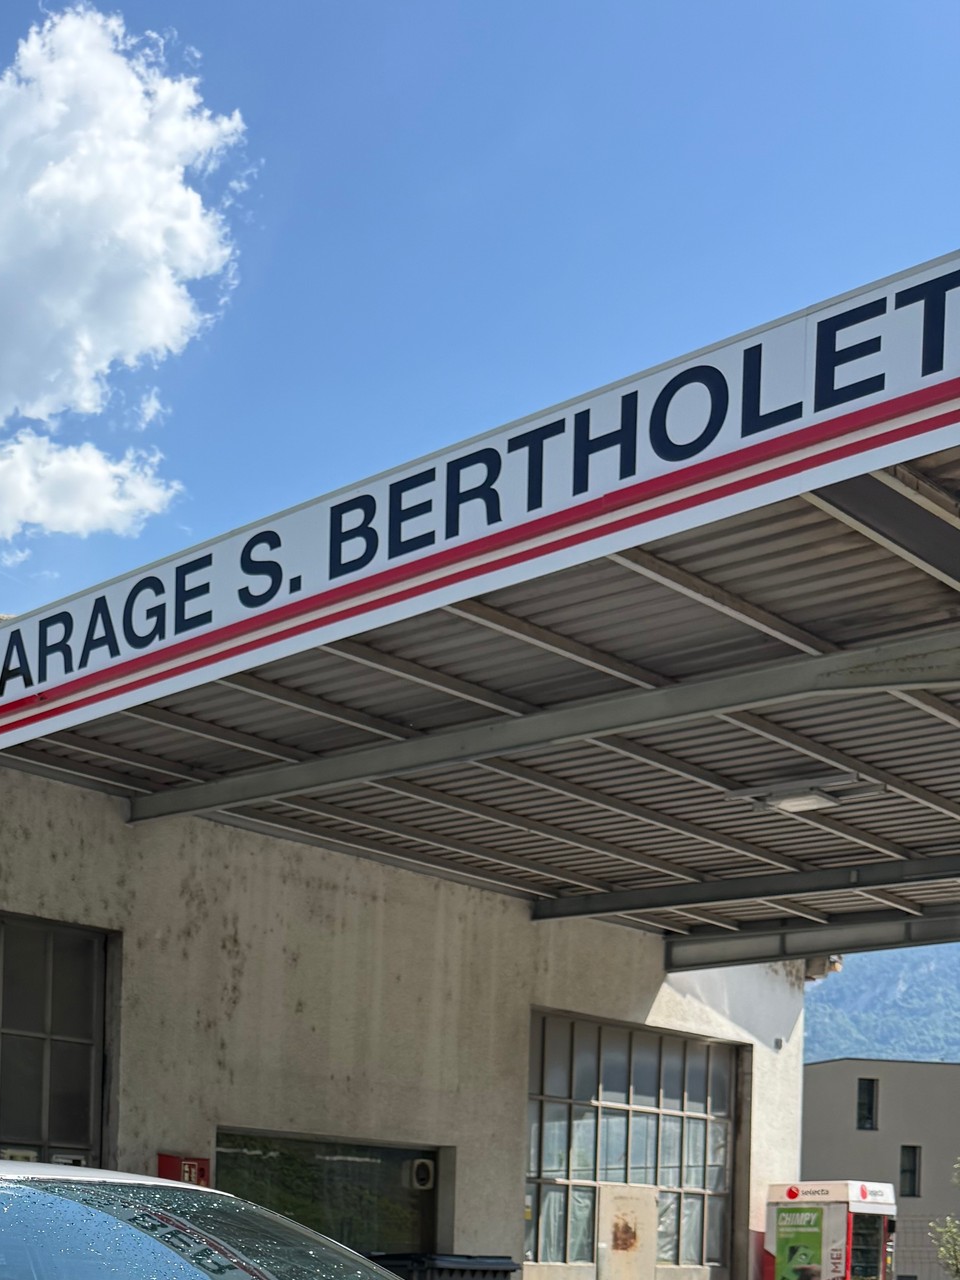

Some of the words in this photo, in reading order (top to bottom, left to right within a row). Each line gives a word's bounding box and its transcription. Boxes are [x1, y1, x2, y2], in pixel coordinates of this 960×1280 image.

[238, 530, 302, 608] S.
[329, 269, 960, 580] BERTHOLET
[801, 1188, 829, 1197] selecta
[778, 1212, 817, 1225] CHIMPY
